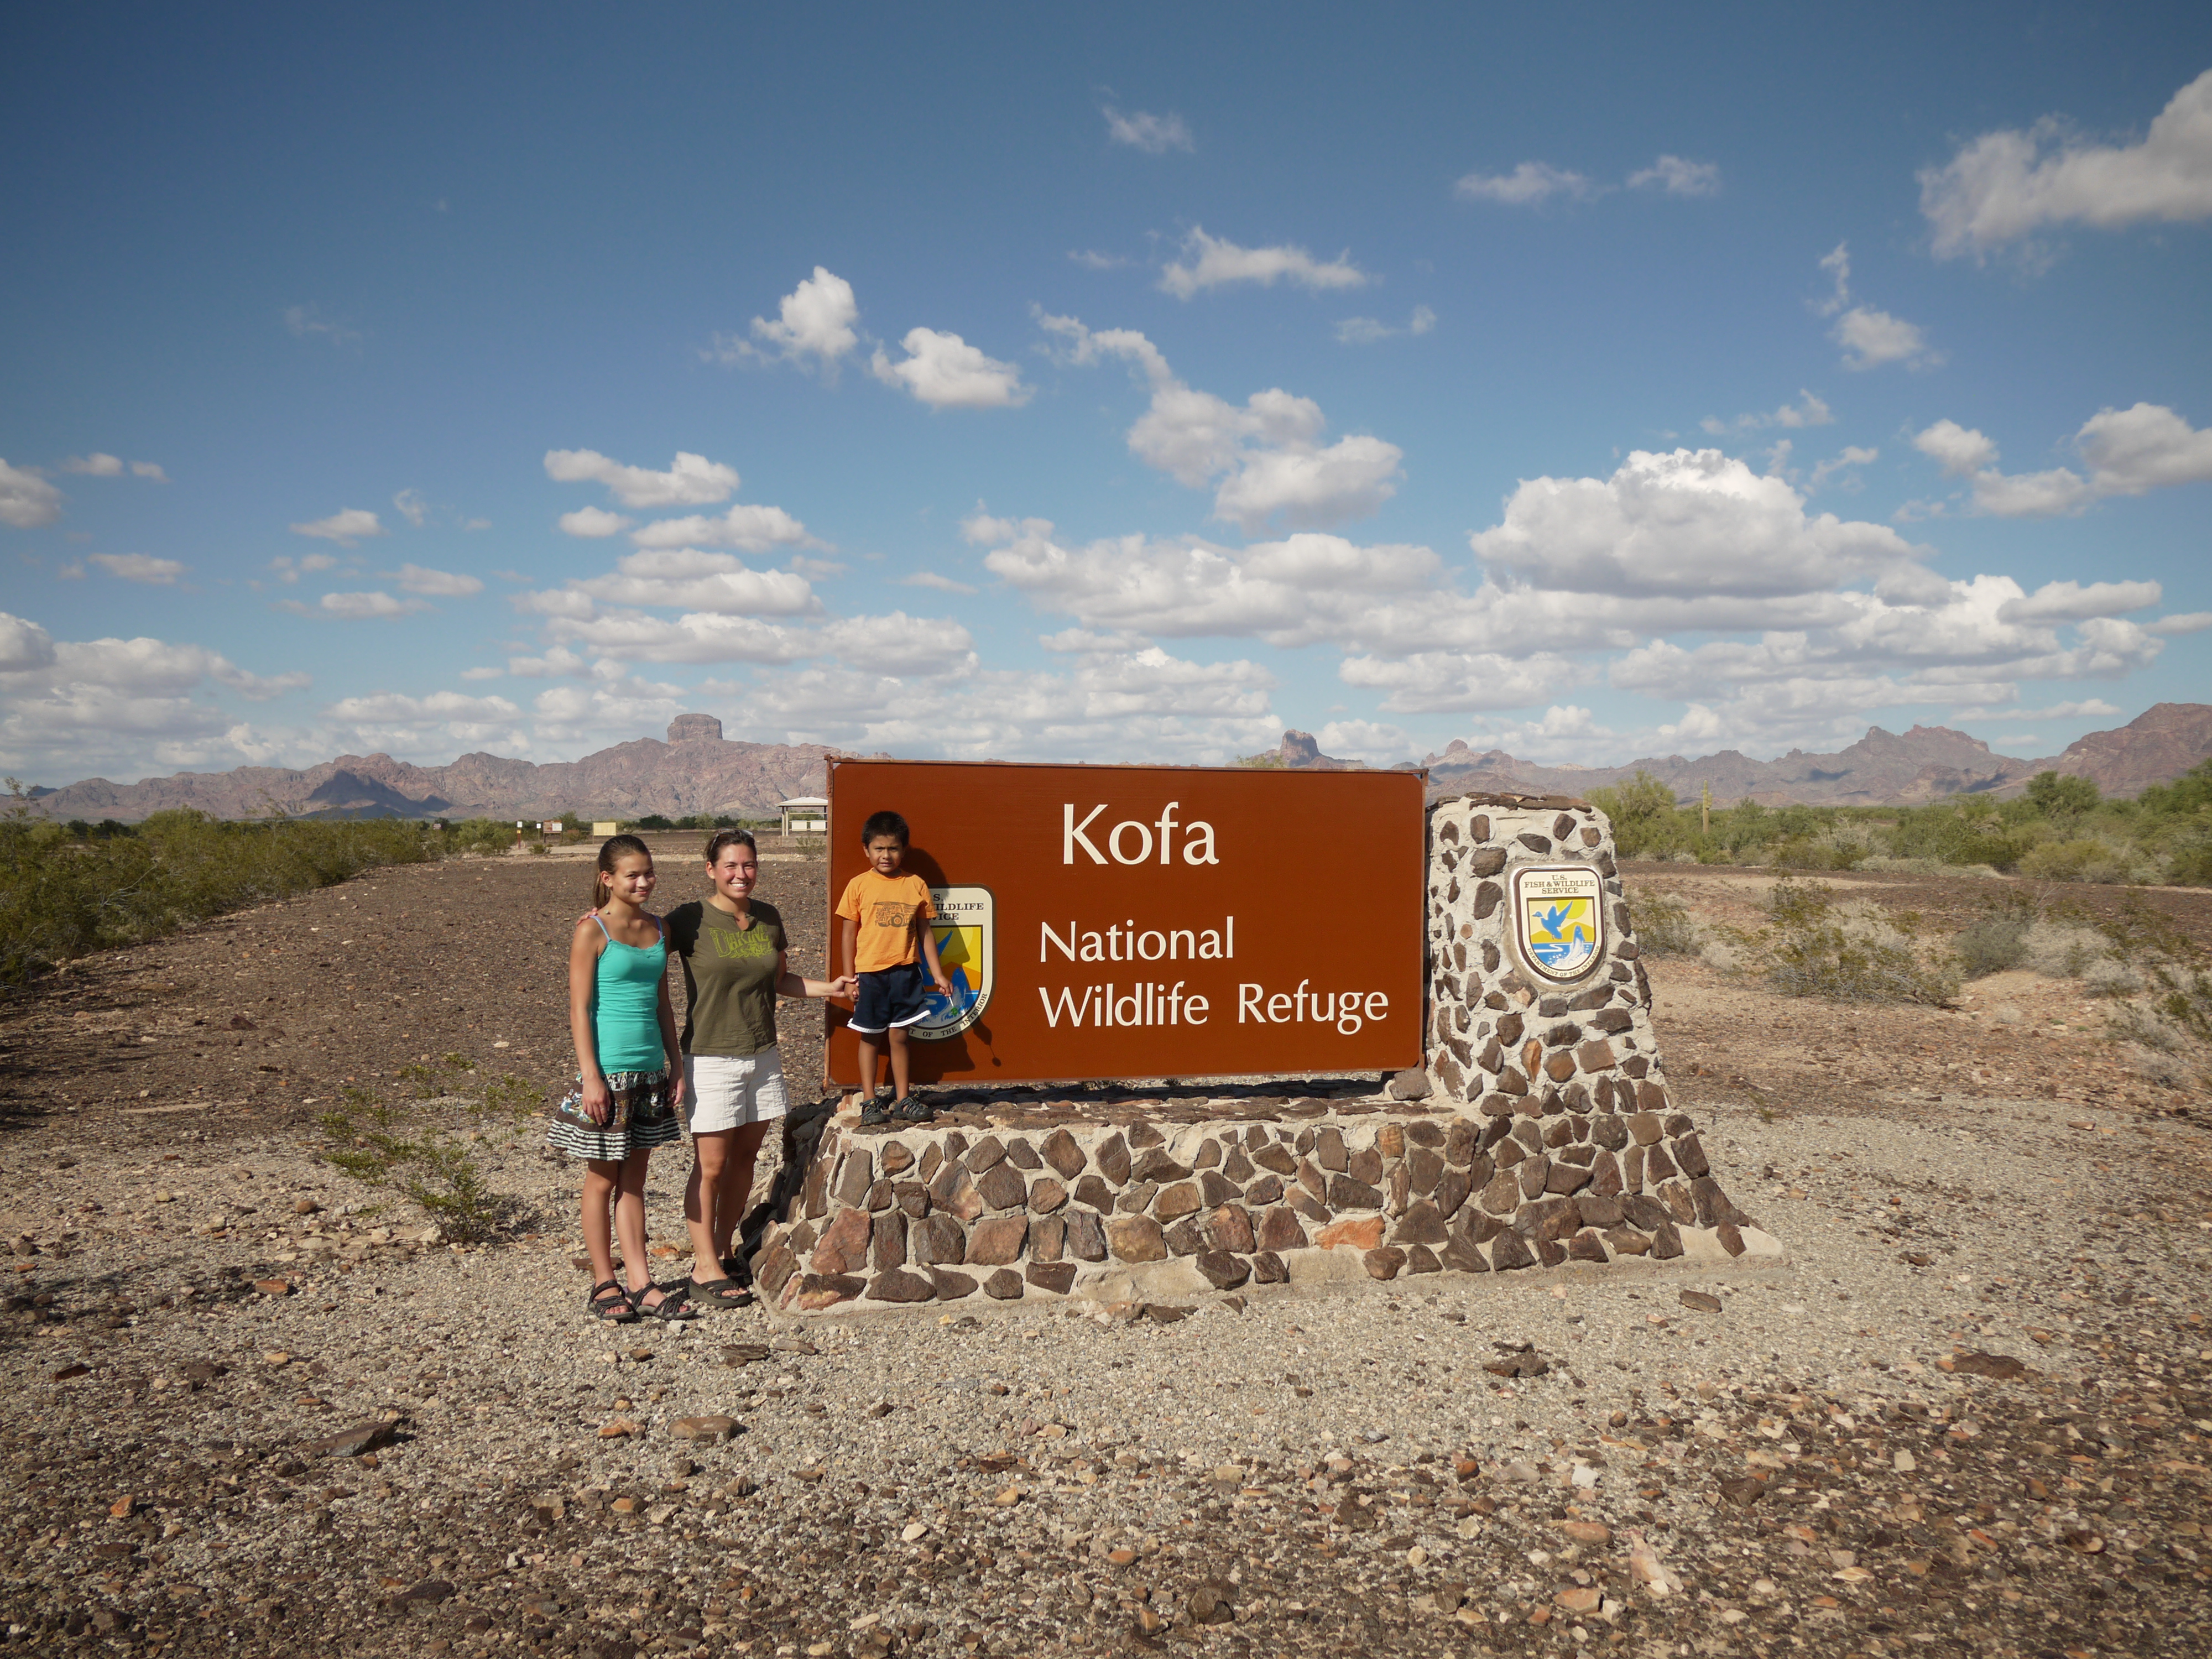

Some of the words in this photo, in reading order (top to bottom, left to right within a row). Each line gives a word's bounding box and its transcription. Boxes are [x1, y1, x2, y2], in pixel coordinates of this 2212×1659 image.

[1063, 801, 1219, 865] Kofa
[1040, 916, 1234, 963] National
[1527, 947, 1559, 975] DEPARTMENT
[941, 1026, 957, 1036] THE
[962, 993, 988, 1026] INTERIOR
[1038, 980, 1209, 1027] Wildlife
[1238, 978, 1389, 1035] Refuge
